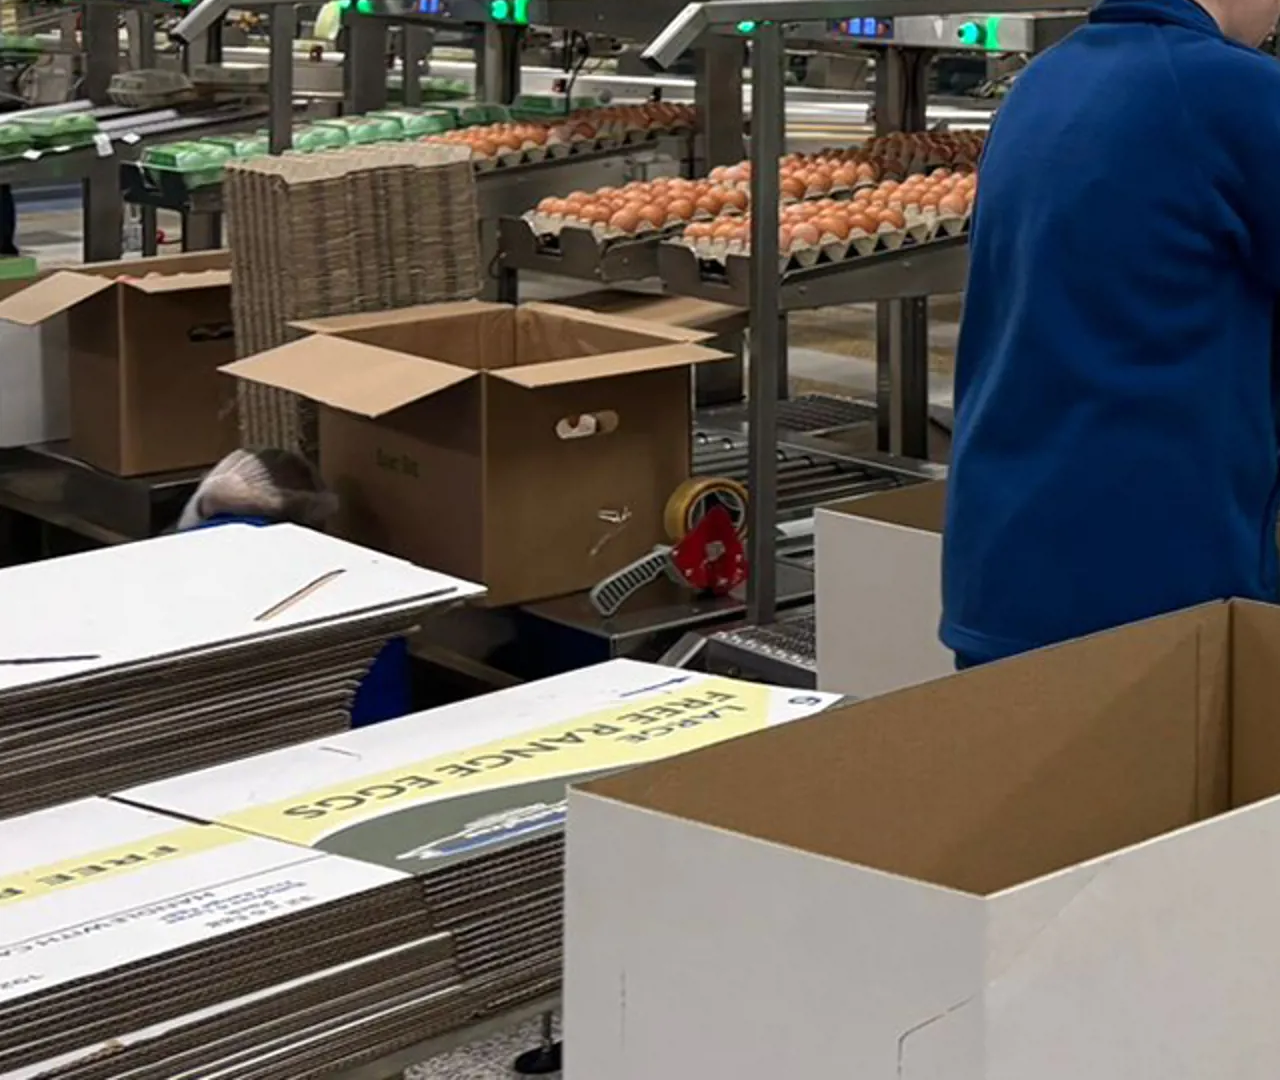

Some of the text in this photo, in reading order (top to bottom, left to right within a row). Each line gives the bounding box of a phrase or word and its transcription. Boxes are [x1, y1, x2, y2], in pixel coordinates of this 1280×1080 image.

[615, 704, 747, 744] LARGE
[283, 690, 737, 820] FREE RANGE EGGS
[36, 844, 179, 886] FREE
